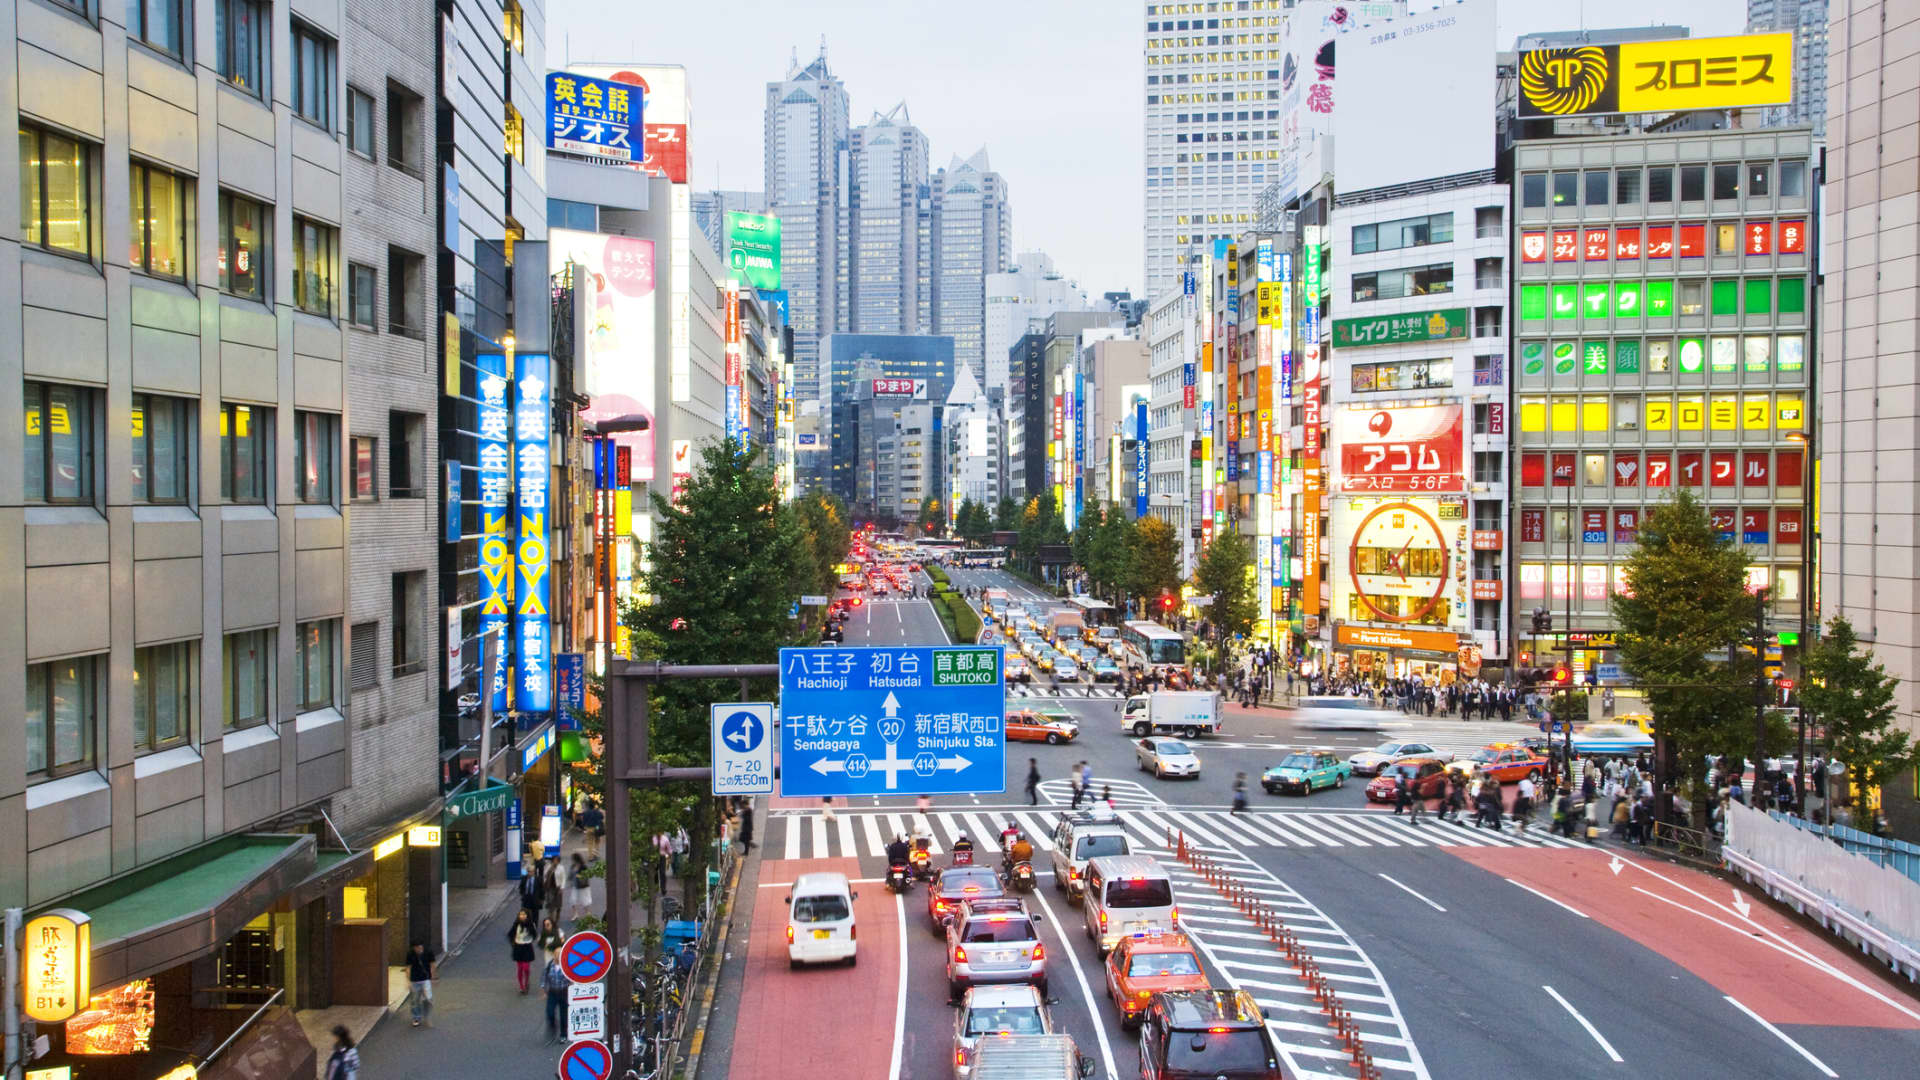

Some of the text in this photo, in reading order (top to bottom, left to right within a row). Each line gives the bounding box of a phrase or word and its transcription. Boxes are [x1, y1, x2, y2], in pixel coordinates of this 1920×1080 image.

[1635, 54, 1774, 92] プロミス
[554, 77, 629, 113] 英会話
[554, 117, 631, 148] ジオス
[1556, 233, 1606, 243] ミスパリ
[1555, 242, 1691, 257] ダイエットセンター
[1556, 292, 1637, 311] レイク
[1351, 320, 1389, 341] レイク
[1391, 329, 1422, 339] コーナー
[875, 380, 912, 393] やまや
[1305, 388, 1319, 424] アコム
[1492, 405, 1502, 432] アコム
[1651, 407, 1765, 424] プロミス
[519, 409, 546, 508] 英会話
[1362, 444, 1441, 473] アコム
[1555, 465, 1572, 476] 4F
[1650, 461, 1766, 479] アイフル
[1780, 523, 1798, 532] 3F
[518, 512, 548, 615] NOVA
[1360, 634, 1379, 644] First
[1380, 636, 1413, 646] Kitchen
[523, 620, 542, 692] 新宿本校
[788, 653, 857, 675] 八王子
[871, 653, 920, 673] 初台
[936, 652, 994, 672] 首都高
[797, 677, 848, 691] Hachioji
[869, 676, 921, 688] Hatsudai
[939, 672, 991, 684] SHUTOKO
[883, 723, 899, 735] 20
[914, 712, 999, 735] 新宿駅西口
[793, 739, 860, 752] Sendagaya
[917, 736, 997, 749] Shinjuku Sta.
[848, 760, 866, 772] 414
[916, 758, 935, 770] 414
[718, 774, 769, 786] この先50m
[463, 793, 506, 815] Chacott
[36, 997, 53, 1009] B1
